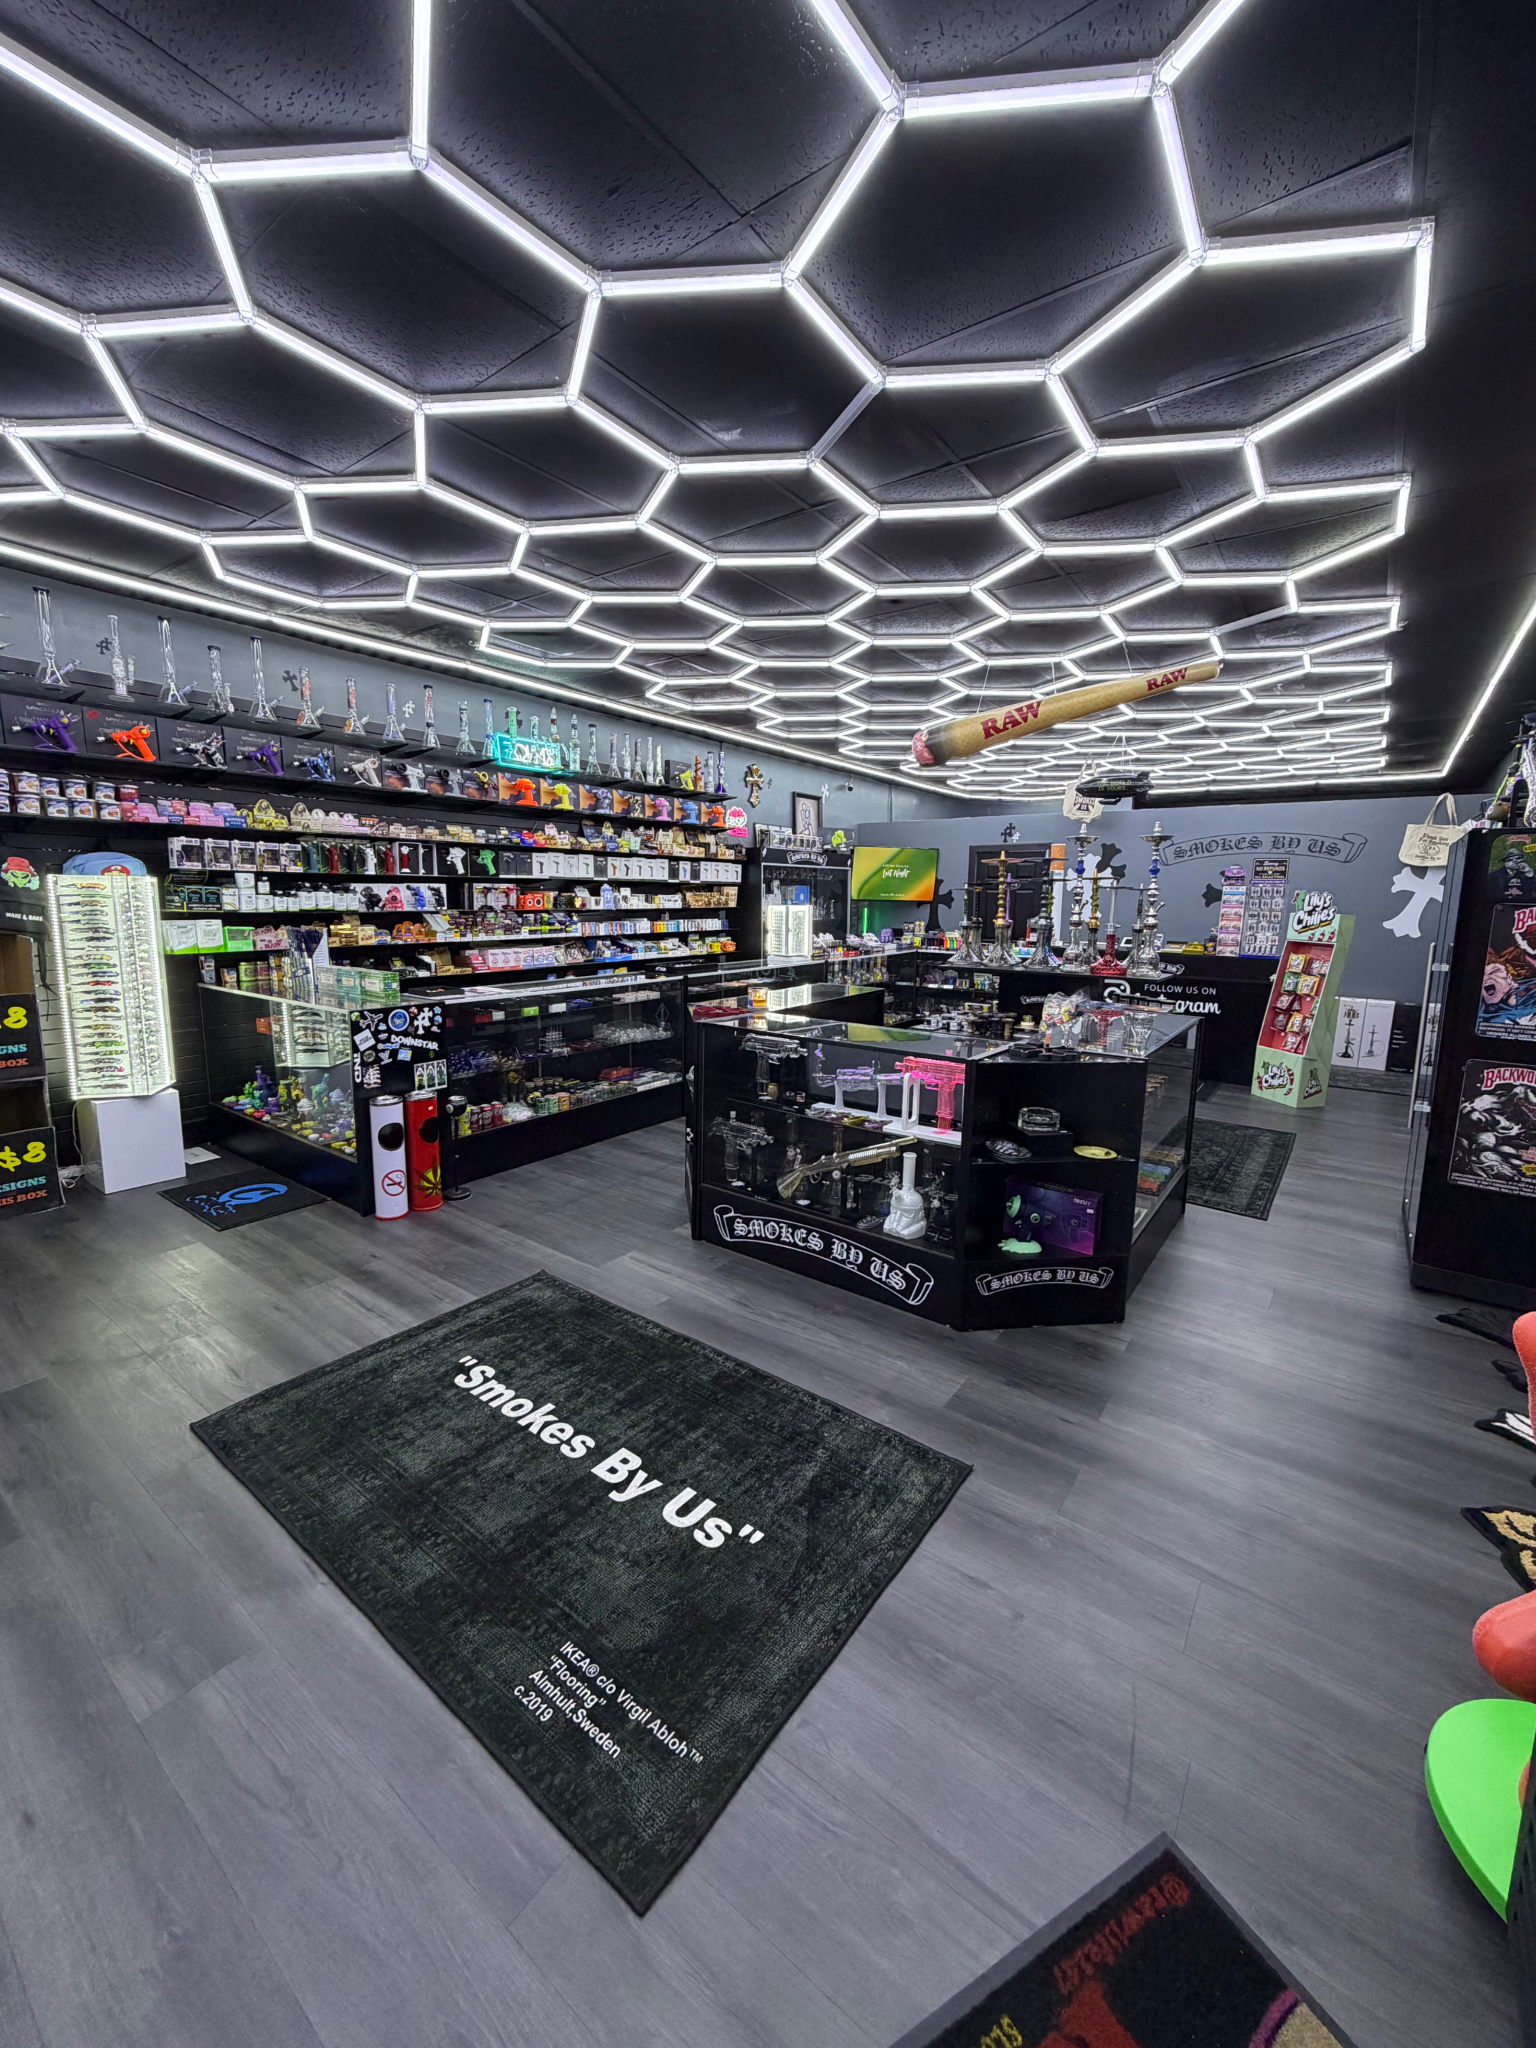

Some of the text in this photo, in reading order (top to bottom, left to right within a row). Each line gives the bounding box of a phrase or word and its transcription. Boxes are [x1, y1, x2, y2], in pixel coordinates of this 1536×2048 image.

[1145, 667, 1190, 692] RAW
[979, 700, 1044, 740] RAW
[1173, 836, 1342, 860] SMOKES BY US
[1303, 892, 1333, 912] Lily's
[1293, 908, 1336, 931] Chilies
[1144, 984, 1217, 995] FOLLOW US ON
[391, 1034, 439, 1051] DOWNSTAR
[1482, 1068, 1536, 1091] BACKWO
[16, 1189, 48, 1202] BOX
[733, 1217, 907, 1291] SMOKES BY US
[990, 1268, 1100, 1291] SMOKES BY US
[454, 1355, 765, 1548] "Smokes By Us"
[513, 1684, 554, 1722] c.2019
[596, 1675, 617, 1694] c/o
[617, 1689, 653, 1724] Virgil
